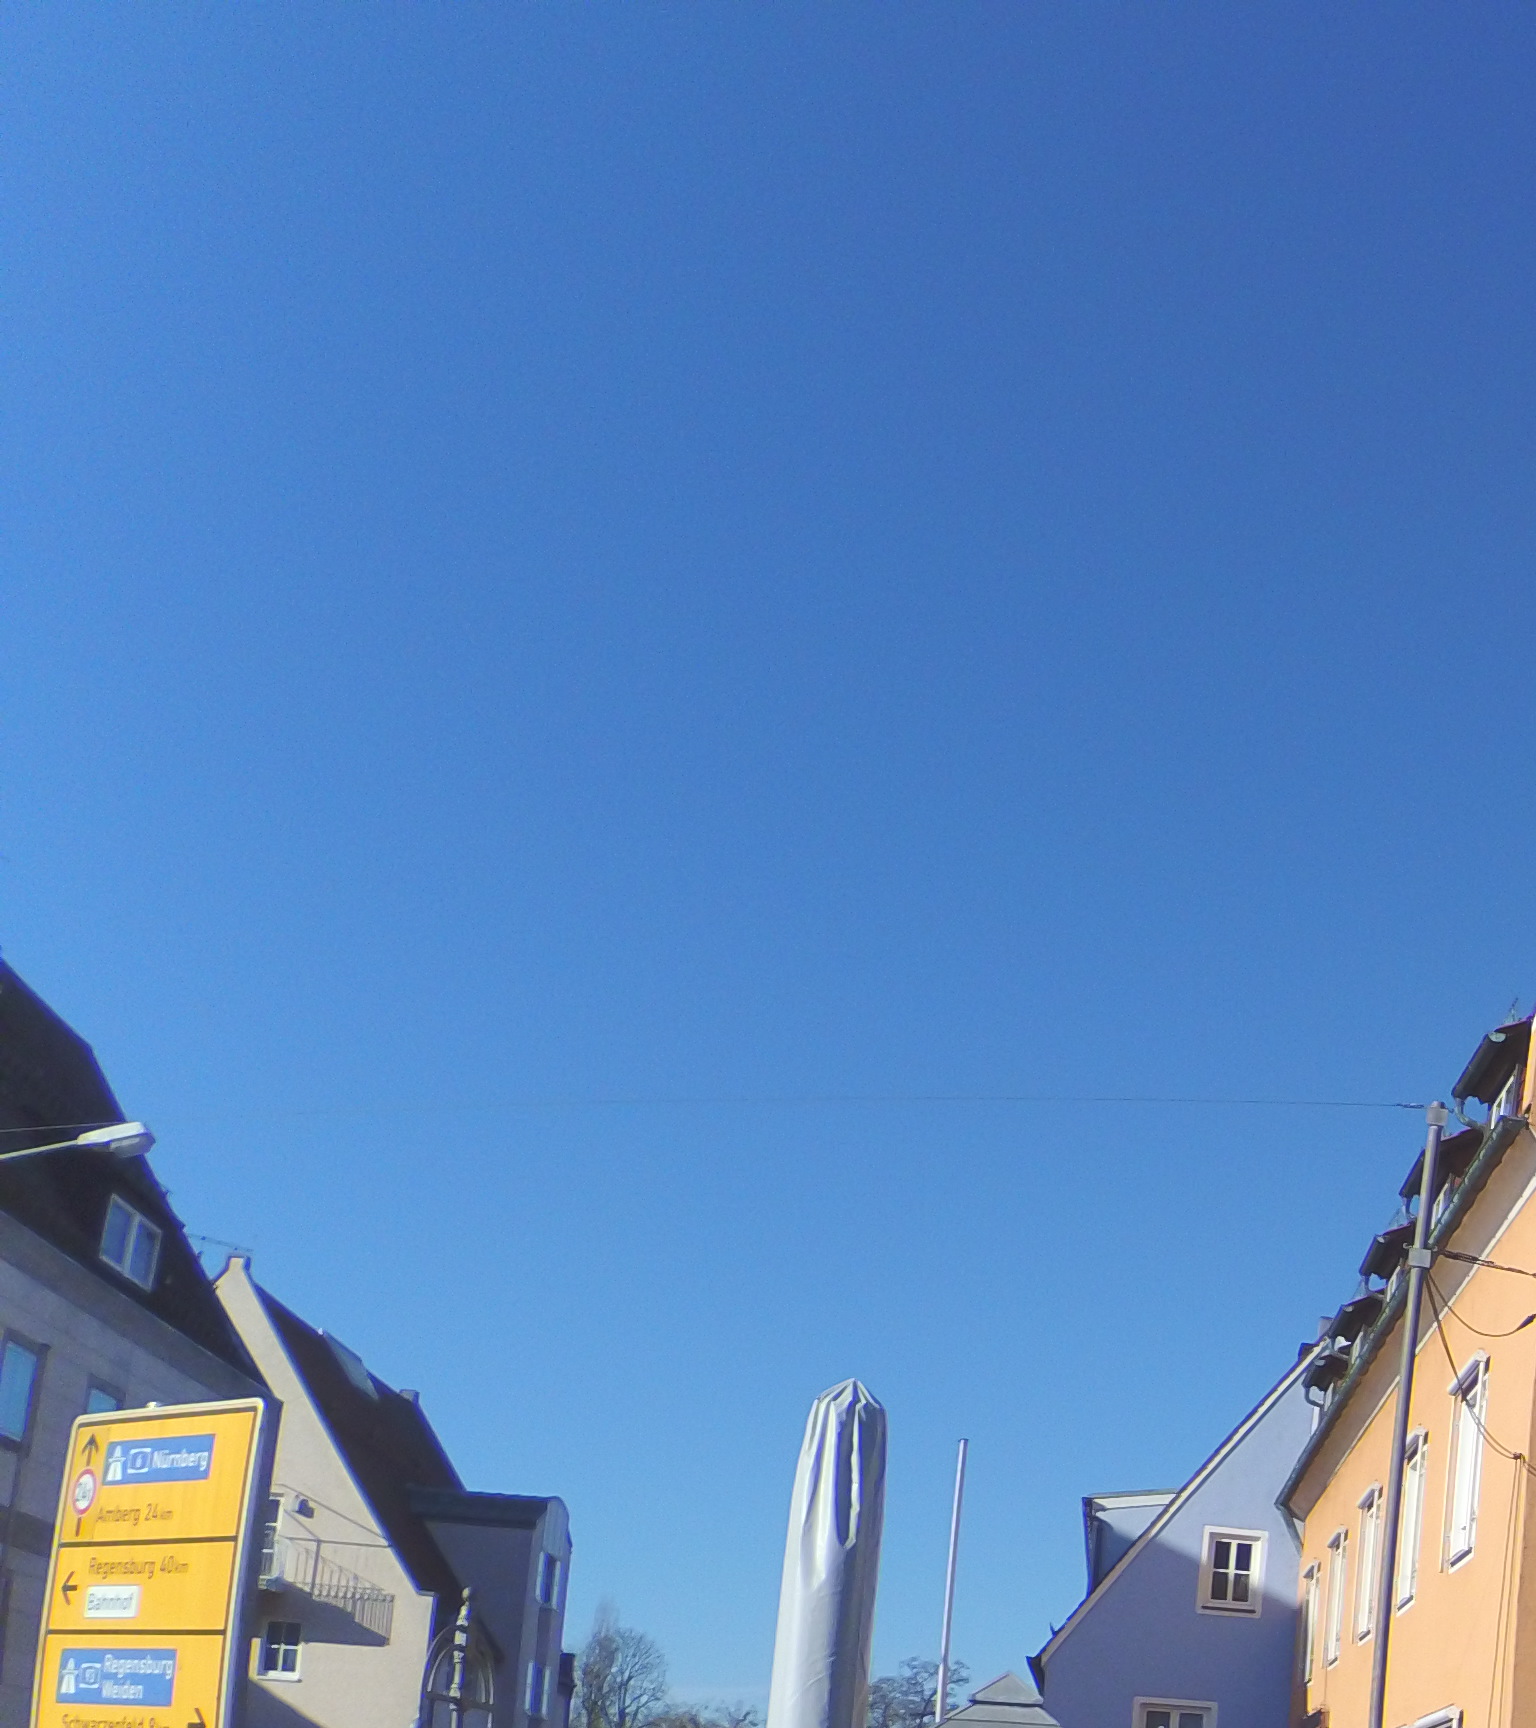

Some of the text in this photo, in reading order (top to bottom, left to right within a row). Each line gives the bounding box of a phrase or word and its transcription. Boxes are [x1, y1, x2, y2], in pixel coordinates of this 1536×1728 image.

[152, 1448, 209, 1471] Nürnberg
[96, 1506, 141, 1526] Amberg
[144, 1503, 158, 1521] 24
[89, 1556, 156, 1579] Regensburg
[160, 1555, 175, 1573] 40
[87, 1592, 134, 1611] Bahnhof
[104, 1653, 173, 1680] Regensburg
[102, 1679, 143, 1699] Weiden
